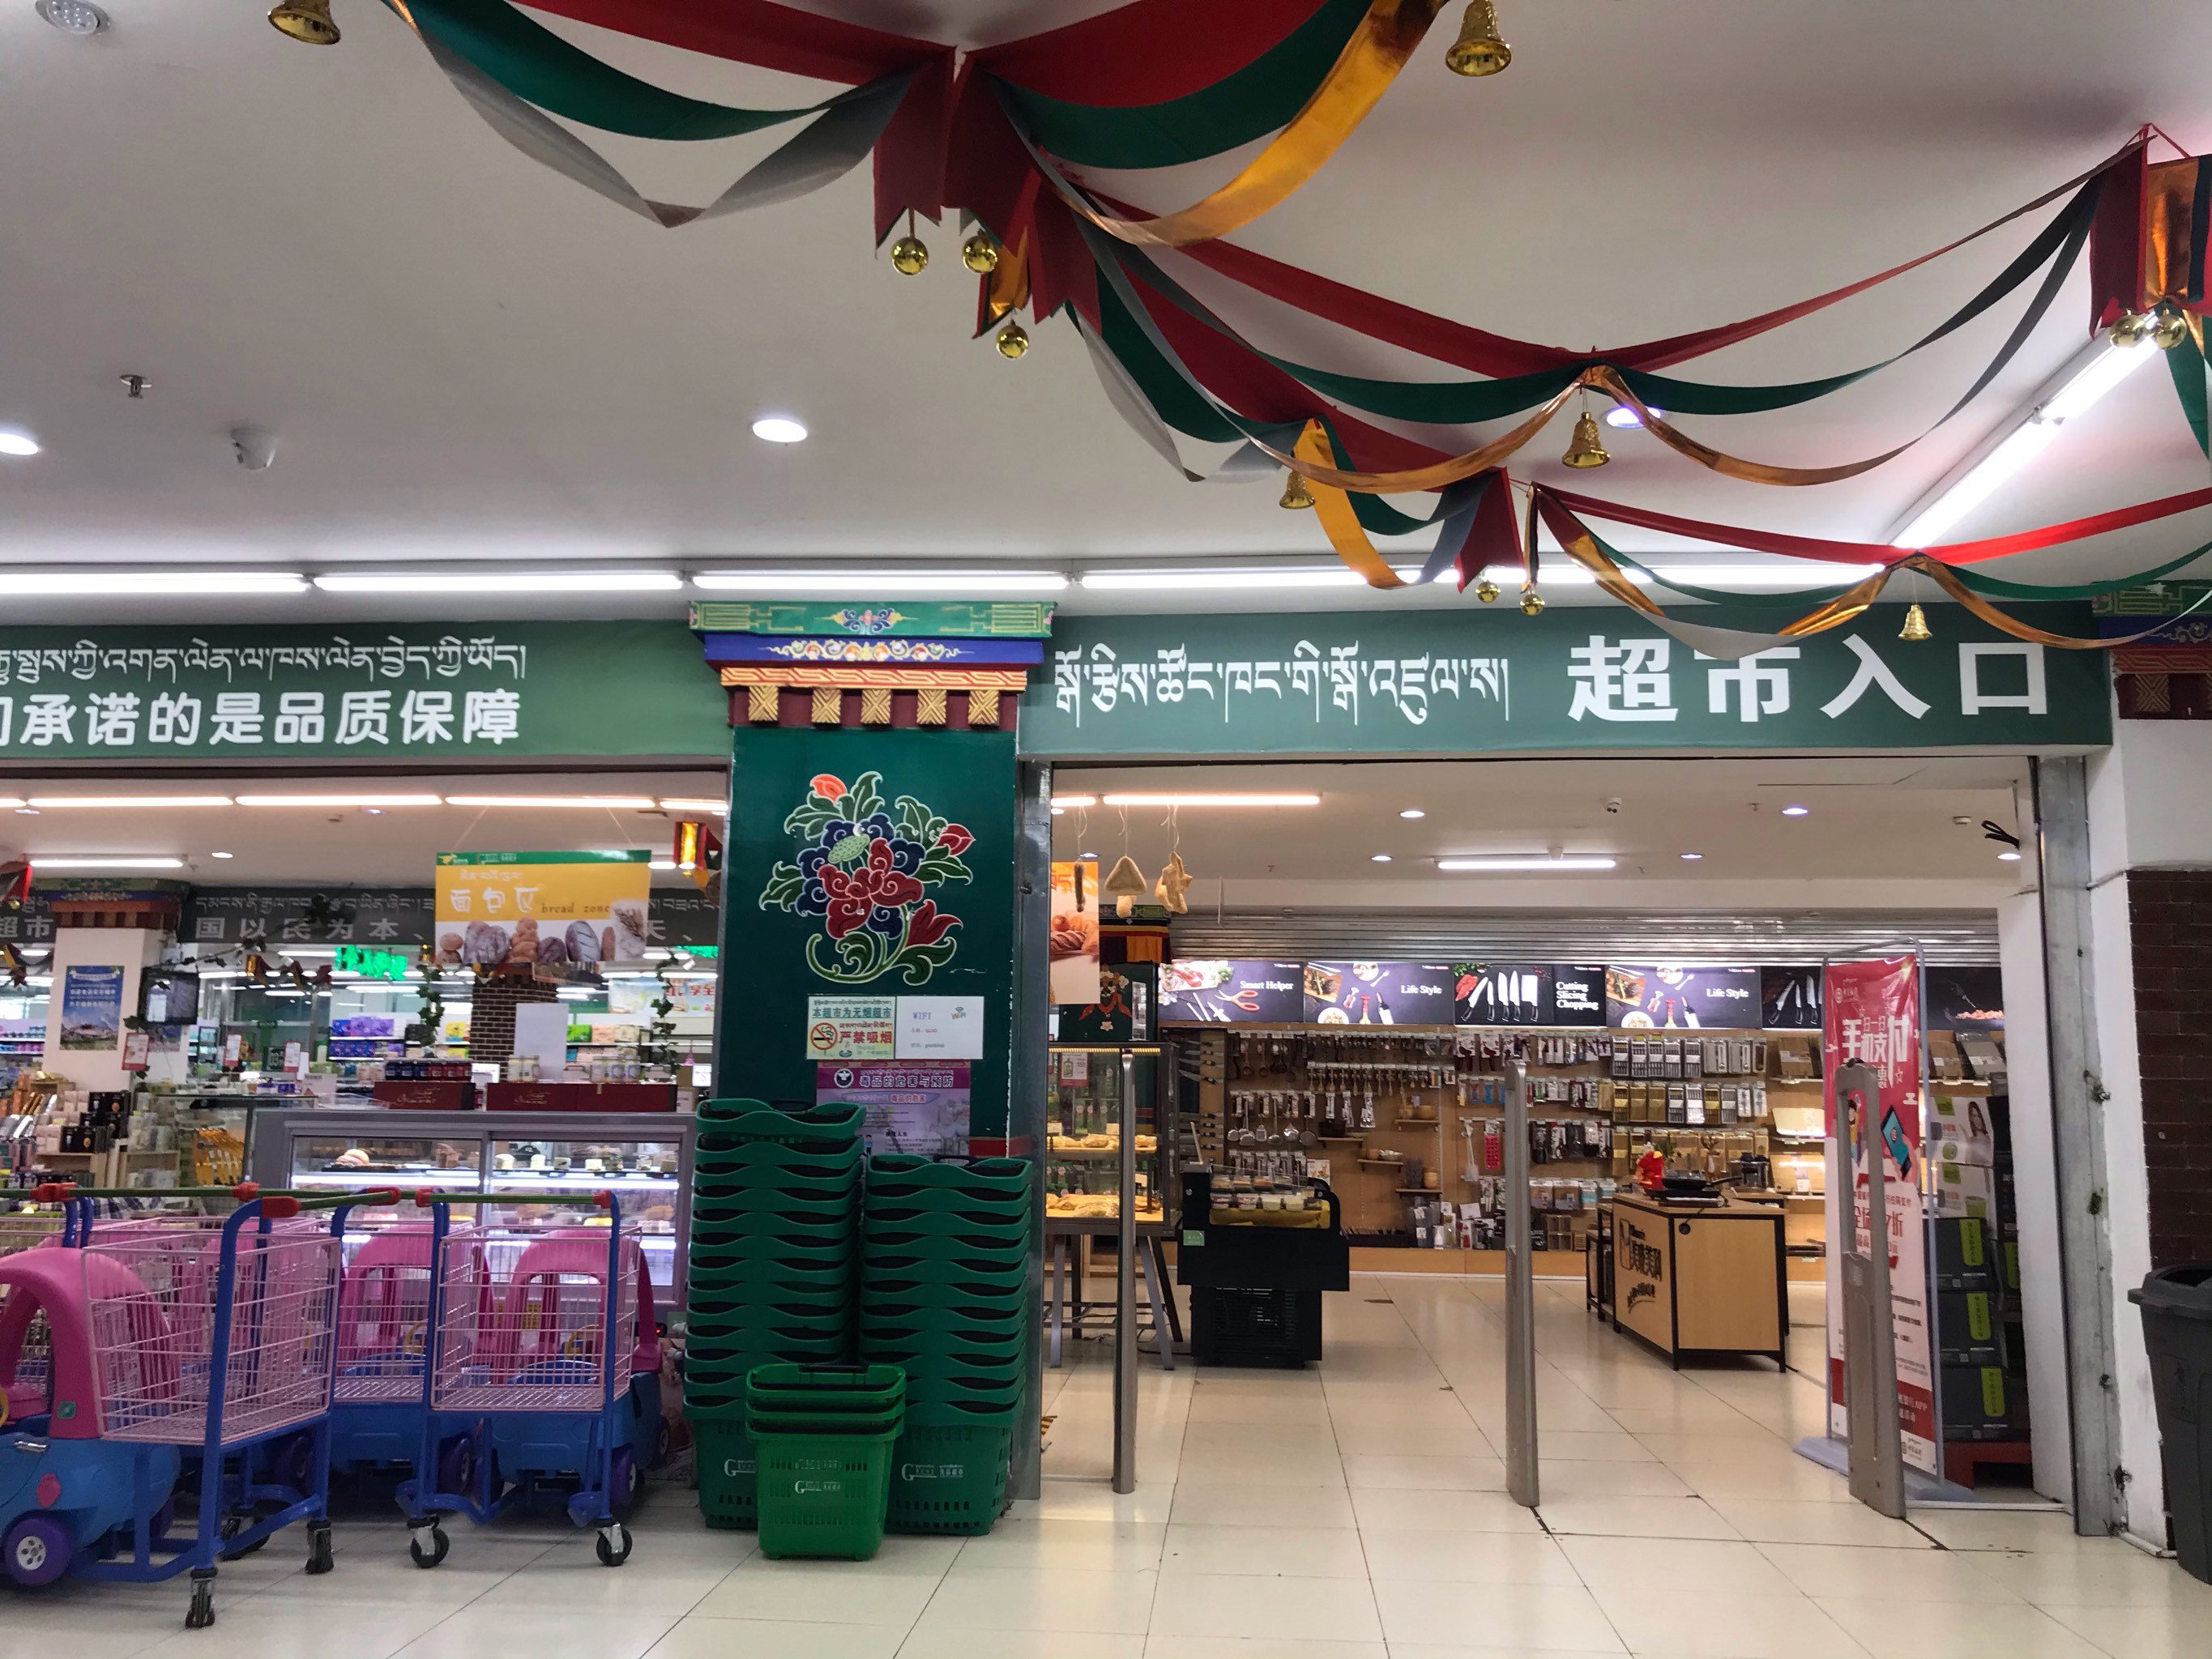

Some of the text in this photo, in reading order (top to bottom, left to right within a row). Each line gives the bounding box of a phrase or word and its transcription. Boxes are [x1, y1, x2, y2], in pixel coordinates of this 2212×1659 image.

[1567, 633, 2048, 723] 超市入口
[450, 887, 540, 914] 面包区
[541, 902, 611, 915] bread zone
[1240, 980, 1294, 992] Smart Helper
[1401, 984, 1442, 996] Life Style
[1556, 981, 1589, 992] Cutting
[1556, 991, 1588, 1002] Slicing
[1706, 987, 1749, 999] Life Style
[1556, 1000, 1599, 1011] Chopping
[812, 1006, 892, 1018] 本超市为无烟超市
[913, 1012, 932, 1020] WIFI
[839, 1030, 893, 1044] 严禁吸烟
[859, 1075, 954, 1088] 毒品的危害与预防
